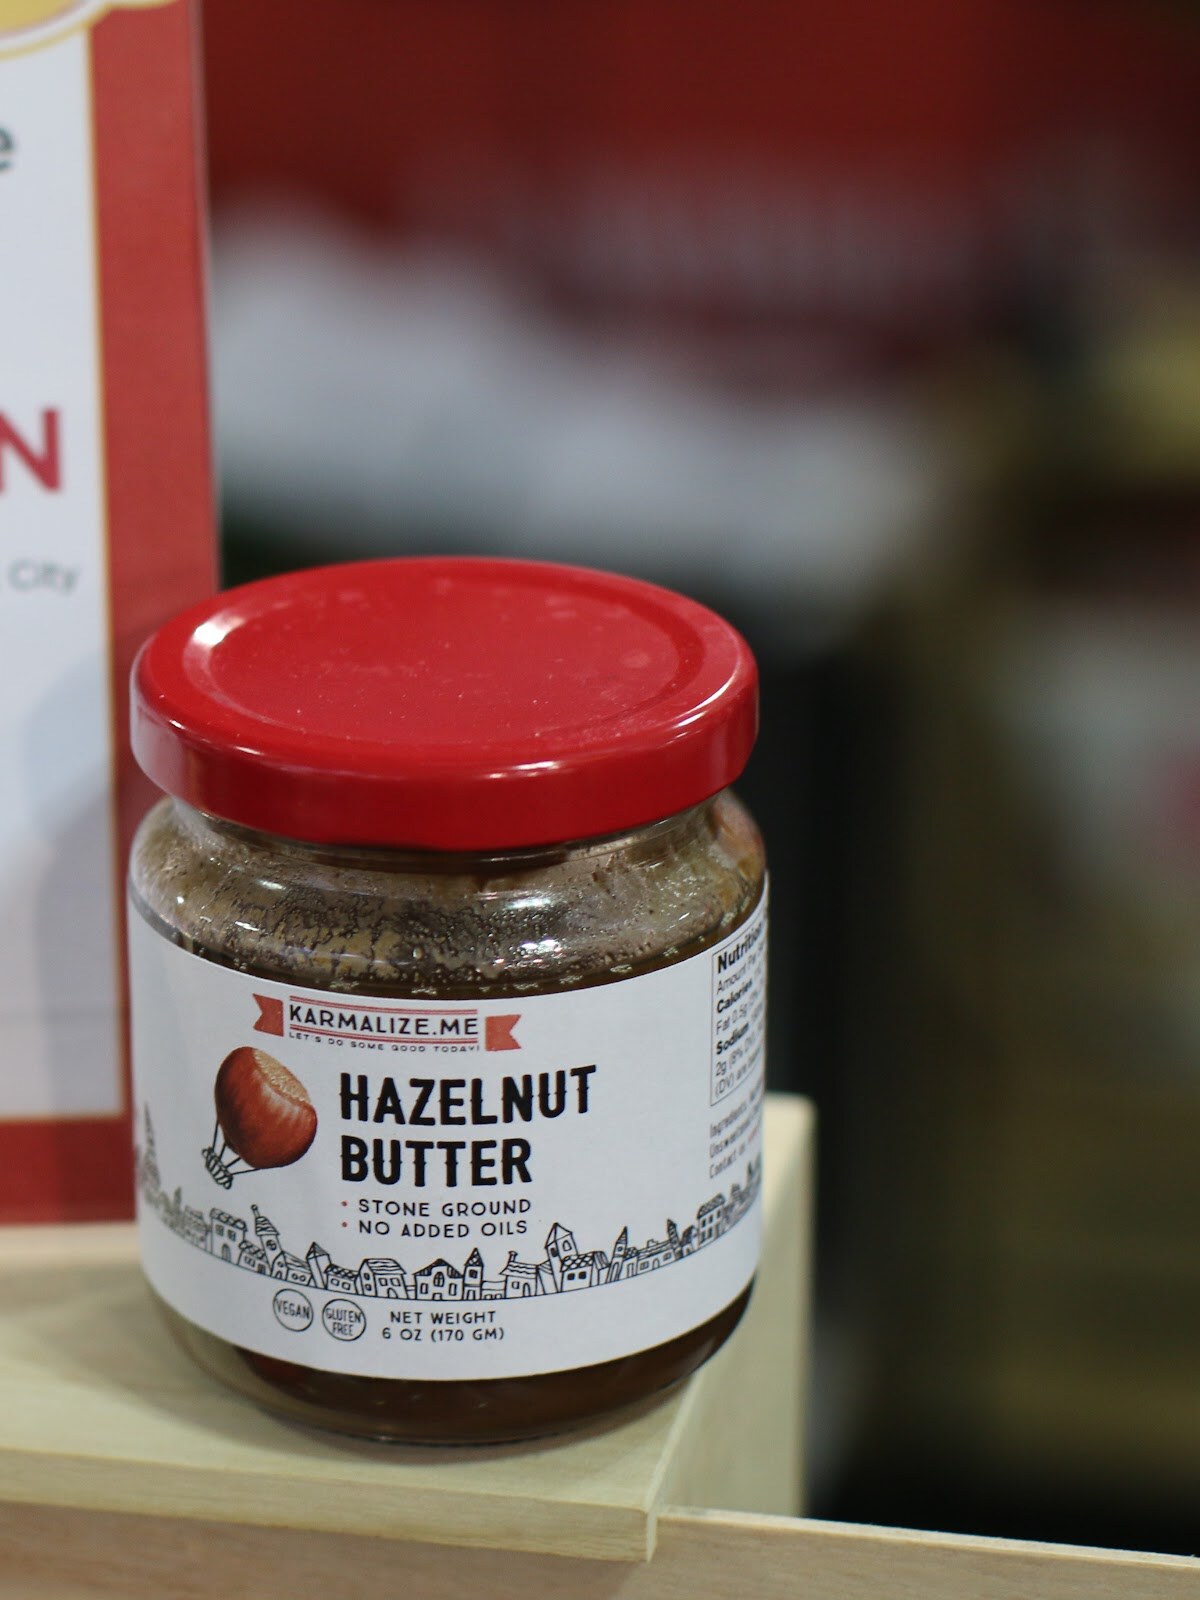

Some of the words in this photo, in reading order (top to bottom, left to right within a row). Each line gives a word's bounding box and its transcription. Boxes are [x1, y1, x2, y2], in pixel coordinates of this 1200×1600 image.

[7, 557, 82, 596] City
[289, 1003, 479, 1036] KARMALIZE.ME
[288, 1031, 321, 1043] LET'S
[328, 1038, 343, 1046] DO
[351, 1041, 383, 1051] SOME
[392, 1044, 425, 1052] GOOD
[340, 1064, 597, 1126] HAZELNUT
[340, 1134, 533, 1188] BUTTER
[358, 1199, 430, 1217] STONE
[441, 1199, 532, 1217] GROUND
[358, 1219, 391, 1236] NO
[401, 1223, 470, 1238] ADDED
[481, 1220, 528, 1237] OILS
[276, 1299, 311, 1321] VEGAN
[325, 1306, 362, 1324] GLUTEN
[390, 1310, 423, 1325] NET
[430, 1310, 497, 1325] WEIGHT
[332, 1321, 354, 1337] FREE
[382, 1329, 392, 1341] 6
[400, 1327, 423, 1342] OZ
[430, 1328, 464, 1343] (170
[473, 1327, 505, 1342] GM)
